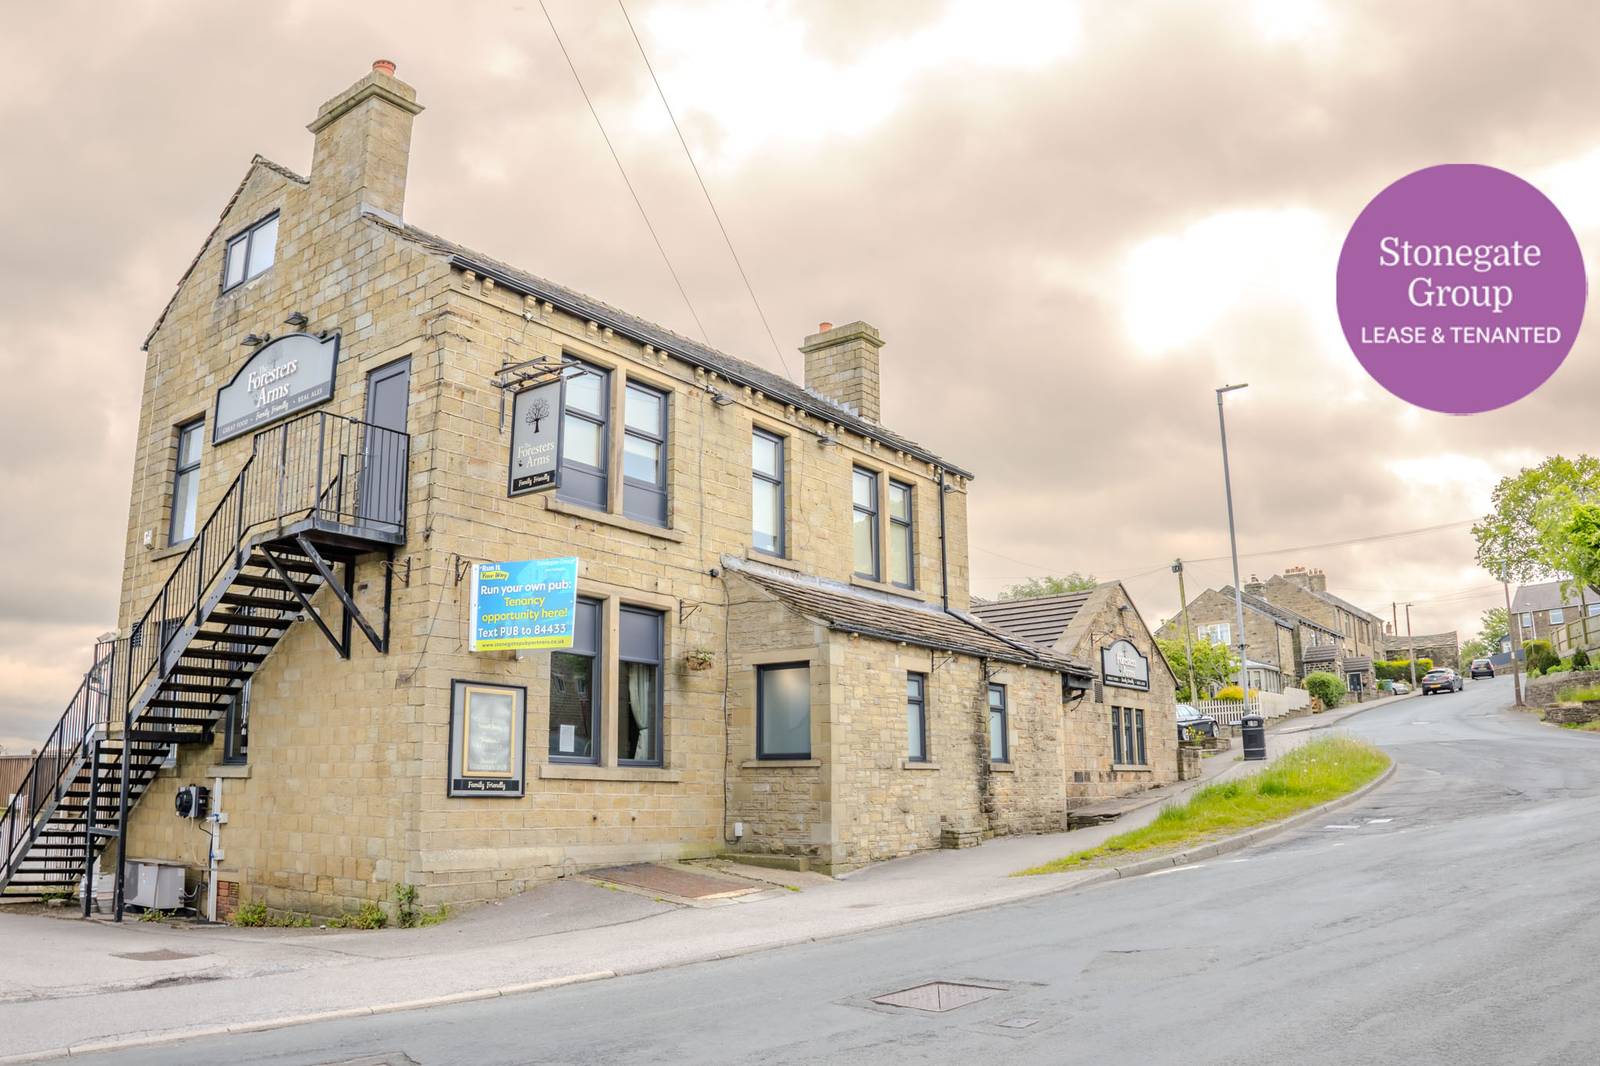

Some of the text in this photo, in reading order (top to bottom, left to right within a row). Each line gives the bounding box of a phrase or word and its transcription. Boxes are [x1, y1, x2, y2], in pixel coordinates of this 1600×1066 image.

[247, 359, 298, 391] Foresters
[256, 383, 290, 407] Arms
[256, 409, 270, 420] Family
[272, 401, 289, 414] Friendly
[517, 441, 554, 458] Foresters
[526, 454, 551, 468] Arms
[518, 473, 550, 487] Family Friendly
[481, 579, 572, 596] Run your own pub:
[504, 597, 545, 607] Tenancy
[481, 608, 568, 624] opportunity here!
[478, 623, 567, 638] Text PUB to 84433
[467, 781, 506, 791] Family Friendly
